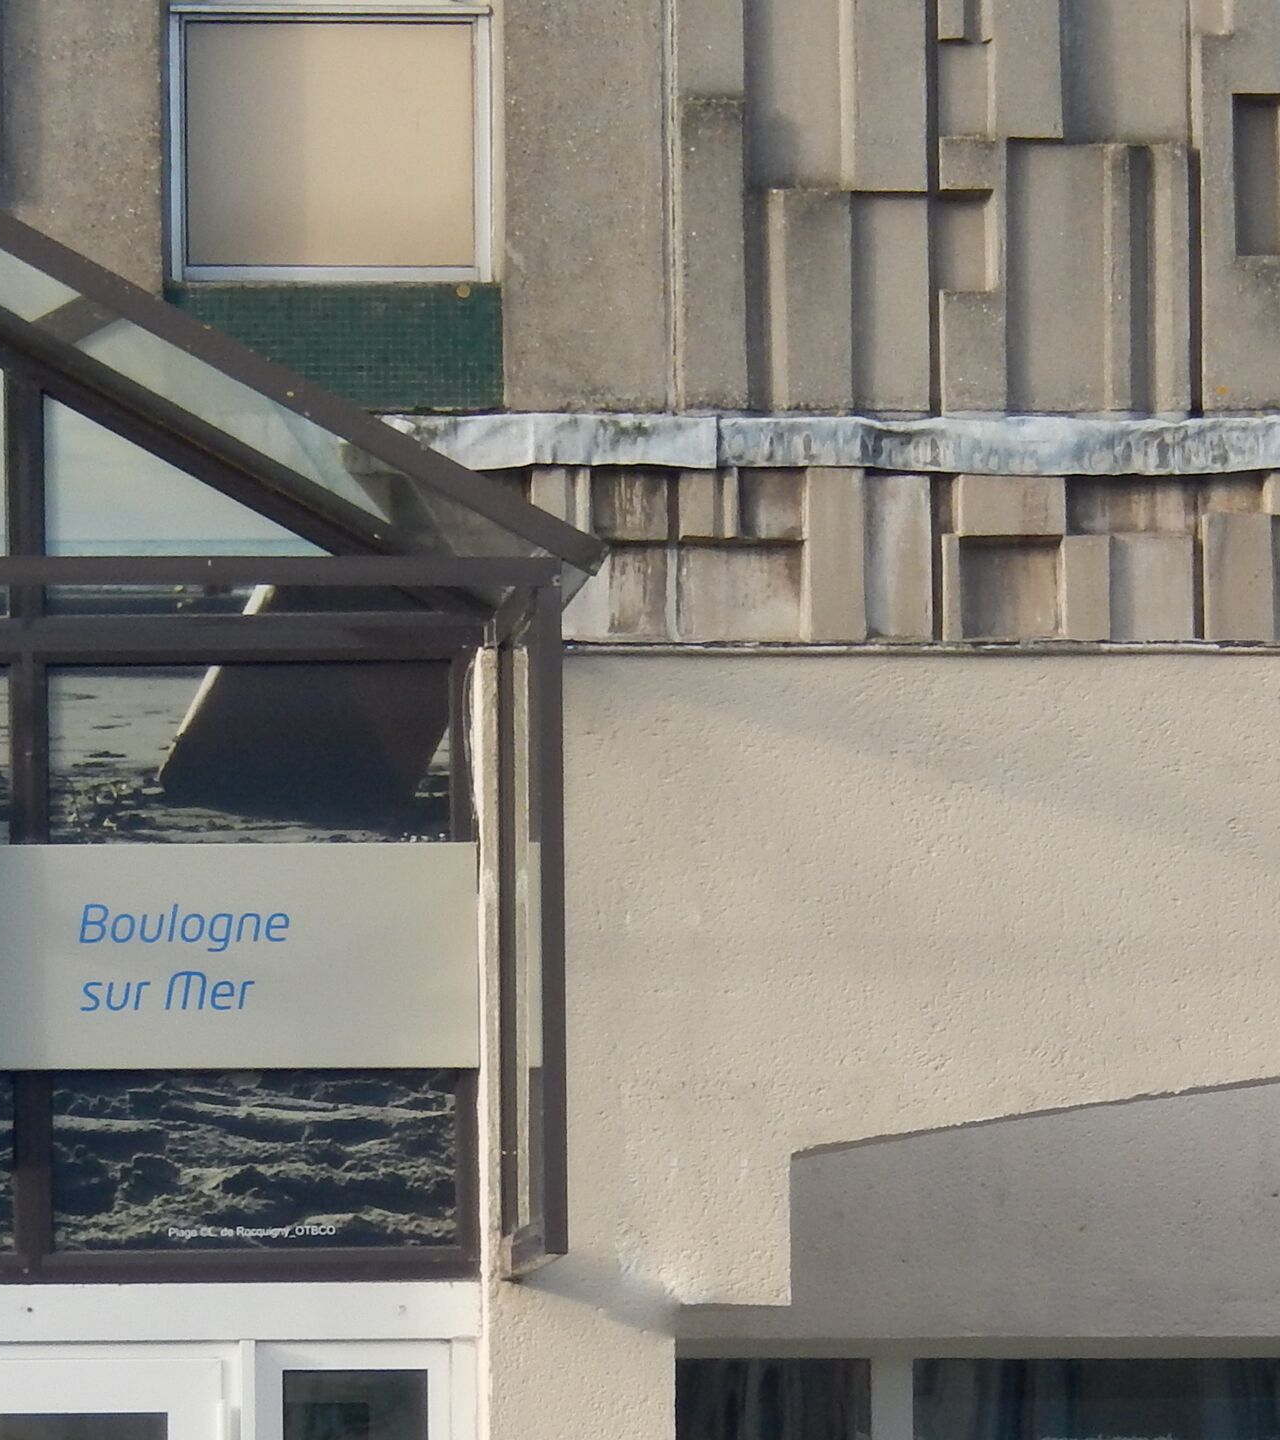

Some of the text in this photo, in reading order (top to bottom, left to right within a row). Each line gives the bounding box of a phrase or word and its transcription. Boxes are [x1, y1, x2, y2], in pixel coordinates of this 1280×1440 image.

[78, 903, 291, 953] Boulogne
[79, 971, 256, 1012] sur Mer
